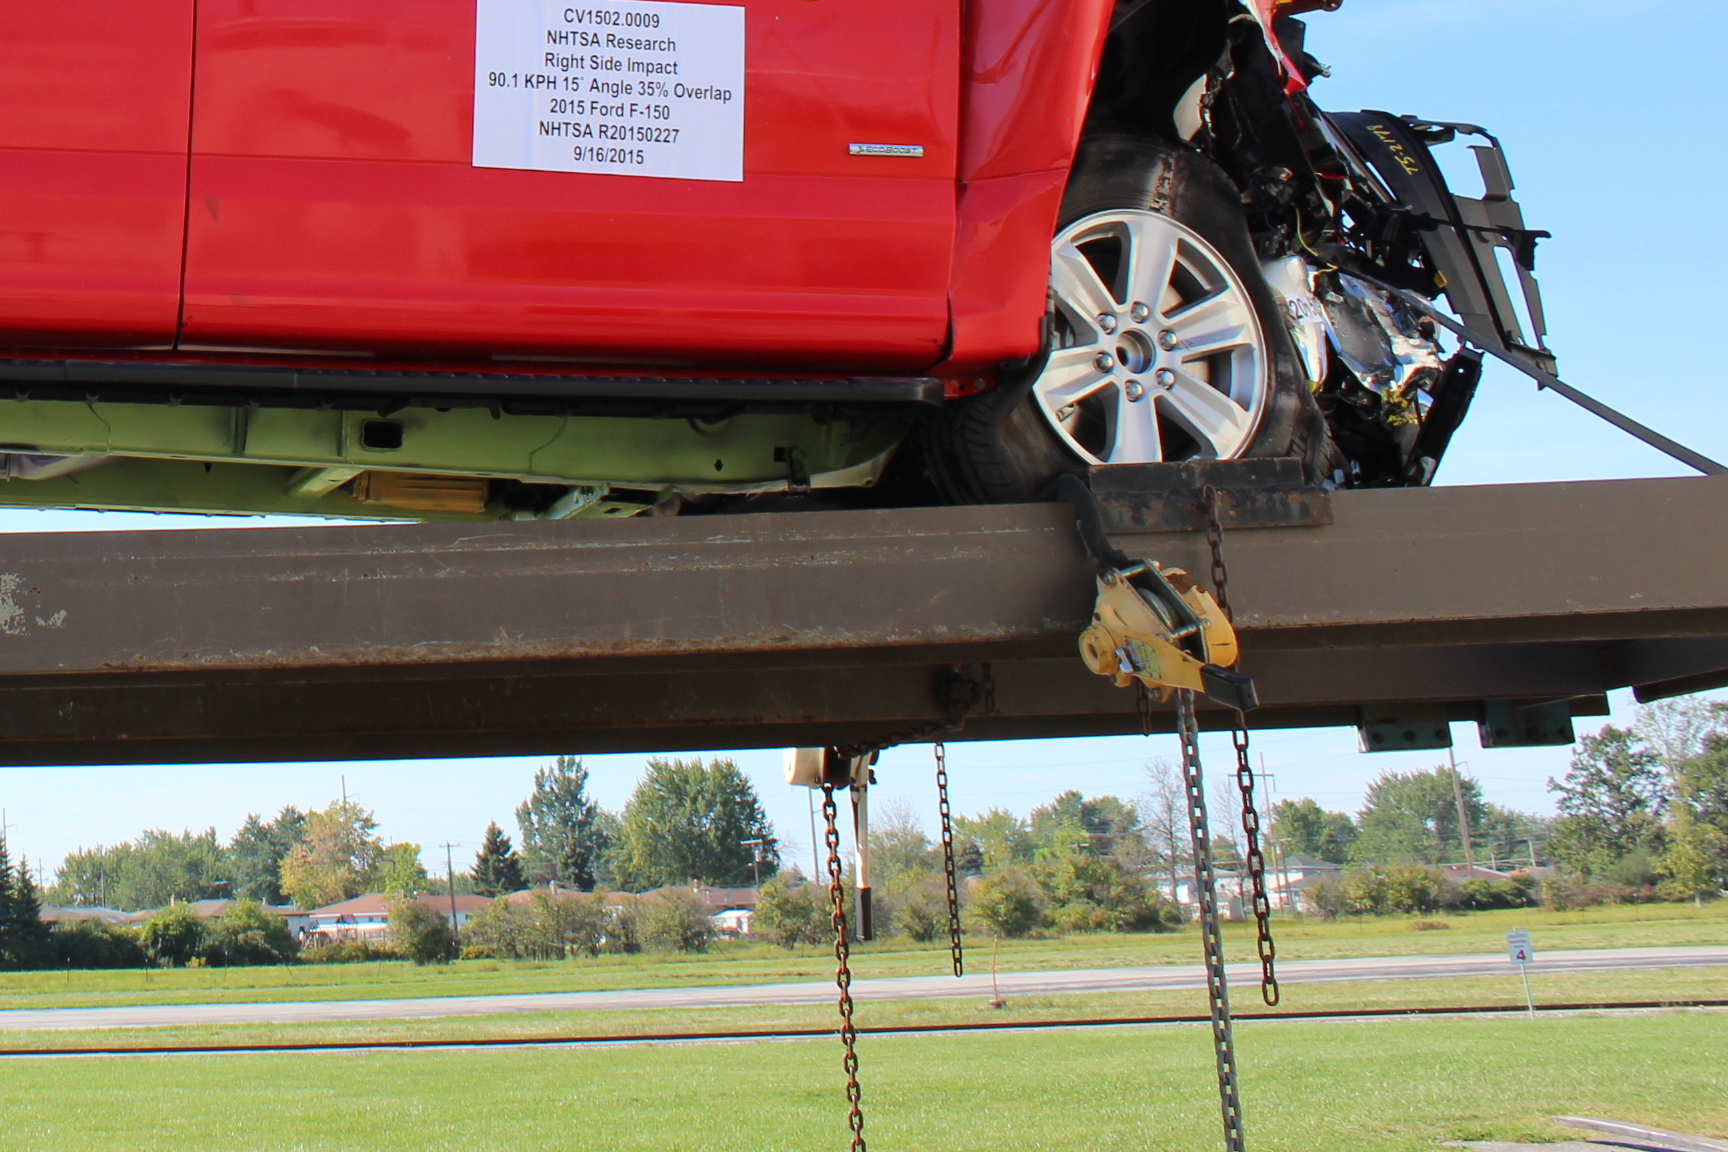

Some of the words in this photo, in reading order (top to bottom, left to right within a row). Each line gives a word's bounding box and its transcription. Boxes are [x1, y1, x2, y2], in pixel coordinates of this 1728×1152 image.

[563, 8, 661, 29] CV1502.0009
[546, 29, 602, 48] NHTSA
[605, 33, 677, 53] Research
[544, 52, 585, 73] Right
[589, 54, 623, 72] Side
[626, 57, 679, 77] Impact
[488, 71, 520, 89] 90.1
[524, 73, 557, 91] KPH
[589, 78, 633, 99] Angle
[637, 80, 669, 98] 35%
[673, 83, 732, 104] Overlap
[549, 98, 585, 116] 2015
[589, 100, 625, 118] Ford
[628, 103, 671, 120] F-150
[538, 120, 594, 140] NHTSA
[598, 124, 680, 144] R20150227
[573, 146, 645, 165] 9/16/2015
